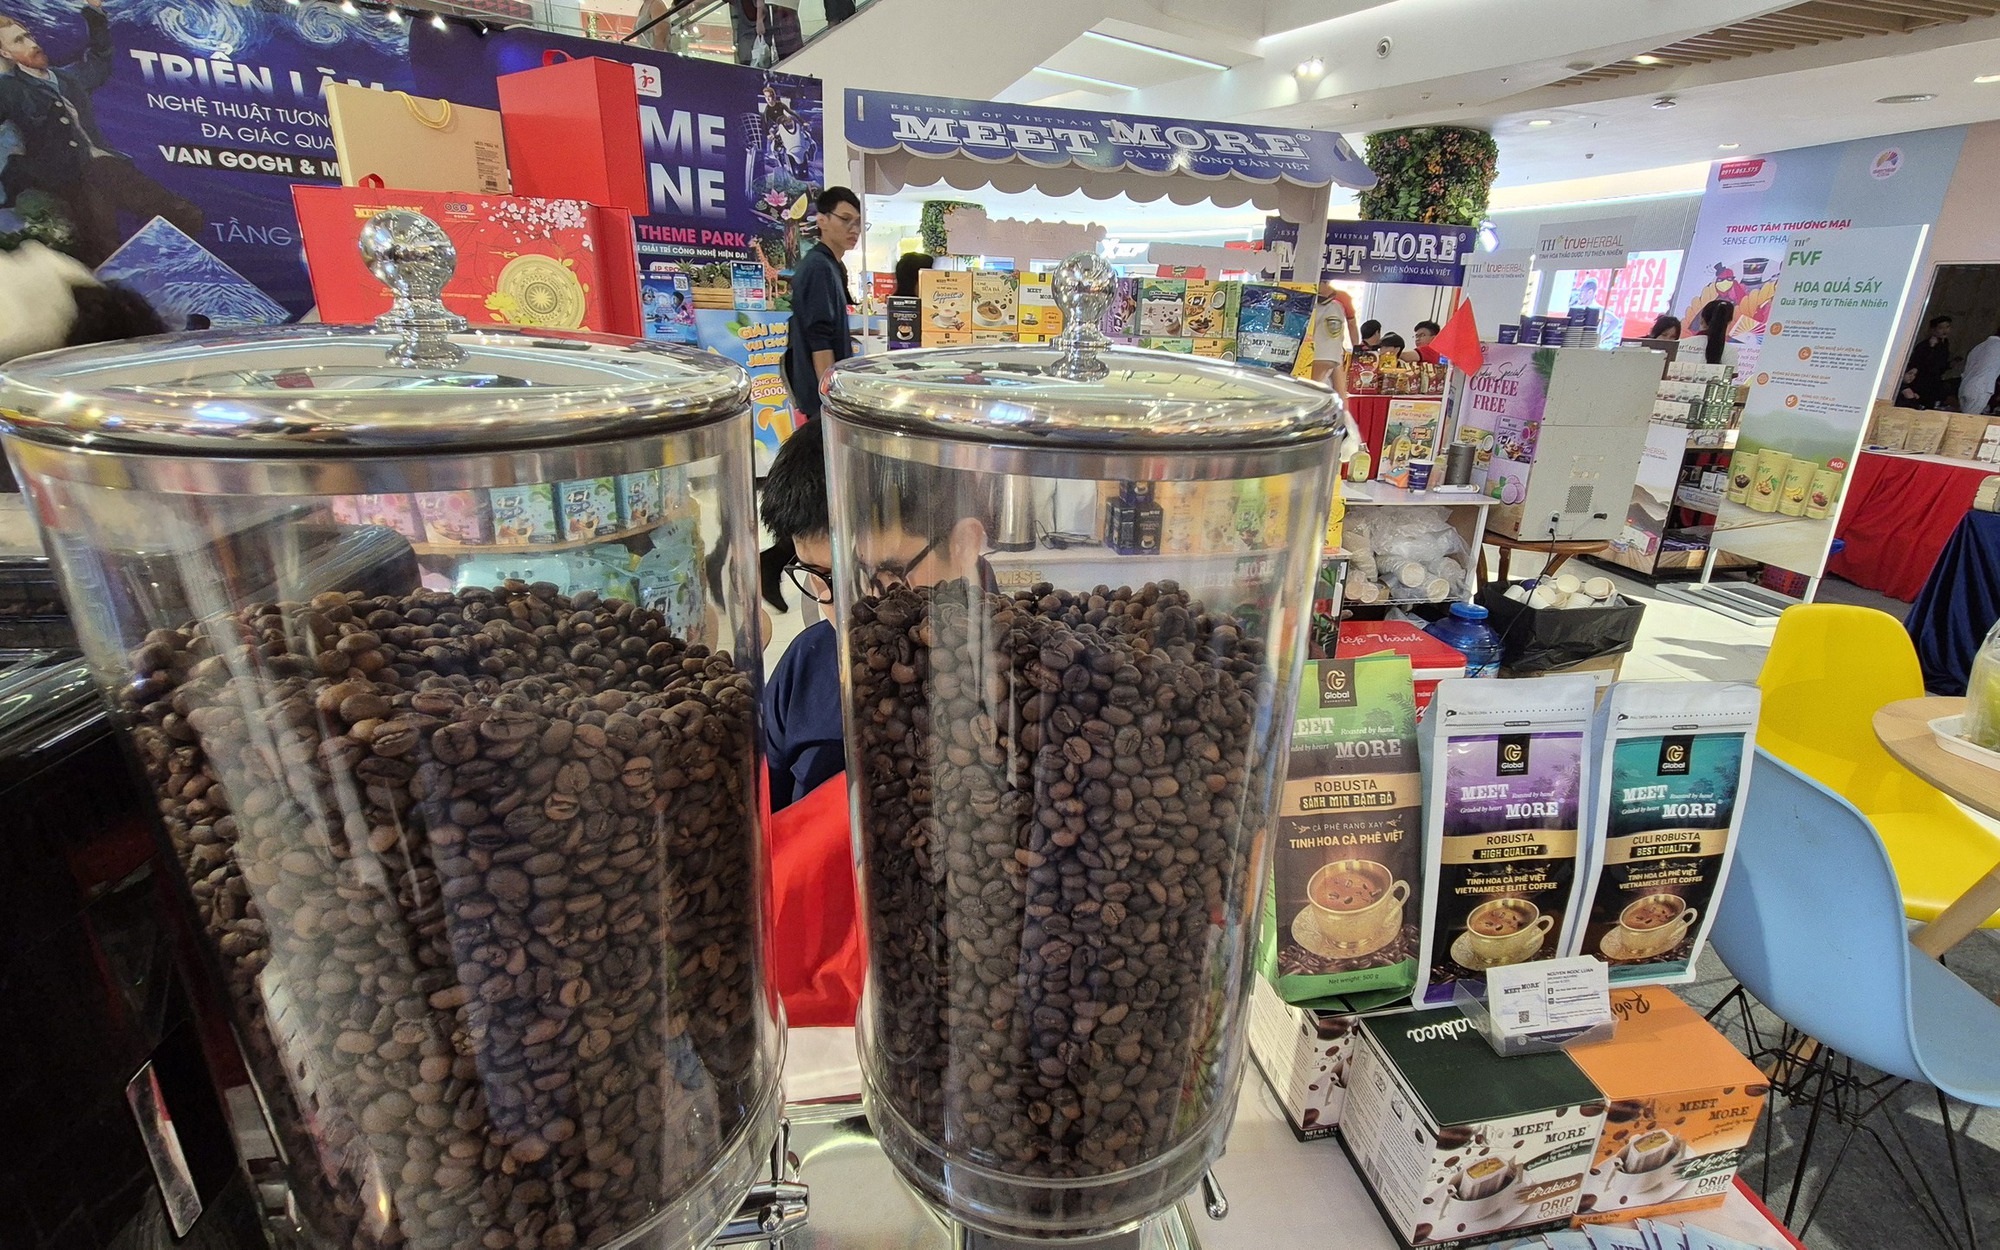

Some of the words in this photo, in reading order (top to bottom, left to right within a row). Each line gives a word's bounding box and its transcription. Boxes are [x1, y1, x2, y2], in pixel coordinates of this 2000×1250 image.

[129, 43, 275, 97] TRIỂN
[147, 93, 208, 117] NGHỆ
[212, 101, 271, 124] THUẬT
[891, 104, 971, 116] ESSENCE
[1013, 115, 1093, 127] VIETNAM
[201, 122, 233, 140] ĐA
[237, 127, 289, 147] GIÁC
[891, 113, 1099, 156] MEET
[1100, 119, 1309, 160] MORE
[158, 145, 212, 166] VAN
[218, 151, 293, 173] GOGH
[300, 159, 316, 176] &
[650, 162, 727, 219] NE
[212, 217, 292, 246] TẦNG
[1726, 225, 1758, 233] TRUNG
[1760, 222, 1781, 232] TÂM
[1783, 219, 1828, 231] THƯƠNG
[1829, 218, 1852, 230] MẠI
[639, 224, 697, 244] THEME
[701, 228, 746, 248] PARK
[1564, 234, 1624, 249] trueHERBAL
[1722, 236, 1747, 245] SENSE
[1749, 235, 1769, 244] CITY
[672, 246, 696, 256] CÔNG
[1370, 231, 1459, 264] MORE
[1788, 250, 1823, 266] FVF
[1793, 280, 1820, 293] HOA
[1823, 276, 1851, 293] QUẢ
[1853, 275, 1883, 293] SẤY
[1834, 298, 1858, 307] Thiên
[1861, 299, 1889, 308] Nhiên
[1469, 375, 1519, 397] COFFEE
[1473, 394, 1507, 414] FREE
[1324, 691, 1350, 700] Global
[1368, 727, 1376, 735] by
[1334, 738, 1401, 759] MORE
[1314, 780, 1378, 793] ROBUSTA
[1460, 784, 1509, 801] MEET
[1622, 784, 1668, 803] MEET
[1505, 802, 1559, 819] MORE
[1662, 803, 1717, 819] MORE
[1312, 823, 1322, 832] CÀ
[1324, 821, 1340, 831] PHÊ
[1343, 822, 1366, 830] RANG
[1368, 821, 1383, 829] XAY
[1289, 838, 1315, 849] TINH
[1315, 836, 1340, 847] HOA
[1342, 833, 1358, 846] CÀ
[1360, 832, 1382, 844] PHÊ
[1384, 830, 1404, 843] VIỆT
[1486, 833, 1534, 845] ROBUSTA
[1632, 836, 1653, 845] CULI
[1655, 832, 1701, 843] ROBUSTA
[1480, 848, 1502, 859] HIGH
[1503, 846, 1539, 858] QUALITY
[1637, 846, 1656, 856] BEST
[1658, 843, 1693, 854] QUALITY
[1503, 875, 1514, 883] CÀ
[1514, 874, 1528, 883] PHÊ
[1529, 874, 1547, 883] VIỆT
[1658, 871, 1667, 879] CÀ
[1668, 868, 1681, 877] PHÊ
[1681, 868, 1698, 876] VIỆT
[1455, 884, 1506, 895] VIETNAMESE
[1507, 883, 1528, 892] ELITE
[1528, 882, 1558, 891] COFFEE
[1619, 881, 1660, 890] VIETNAMESE
[1660, 878, 1677, 886] ELITE
[1678, 876, 1703, 884] COFFEE
[1340, 975, 1361, 983] weight:
[1504, 987, 1521, 995] MEET
[1521, 982, 1539, 990] MORE
[1678, 1098, 1719, 1112] MEET
[1708, 1106, 1749, 1120] MORE
[1512, 1121, 1554, 1138] MEET
[1544, 1127, 1587, 1144] MORE
[1698, 1174, 1731, 1188] DRIP
[1527, 1179, 1578, 1200] Arabica
[1695, 1183, 1727, 1195] COFFEE
[1540, 1196, 1574, 1212] DRIP
[1536, 1206, 1572, 1219] COFFEE
